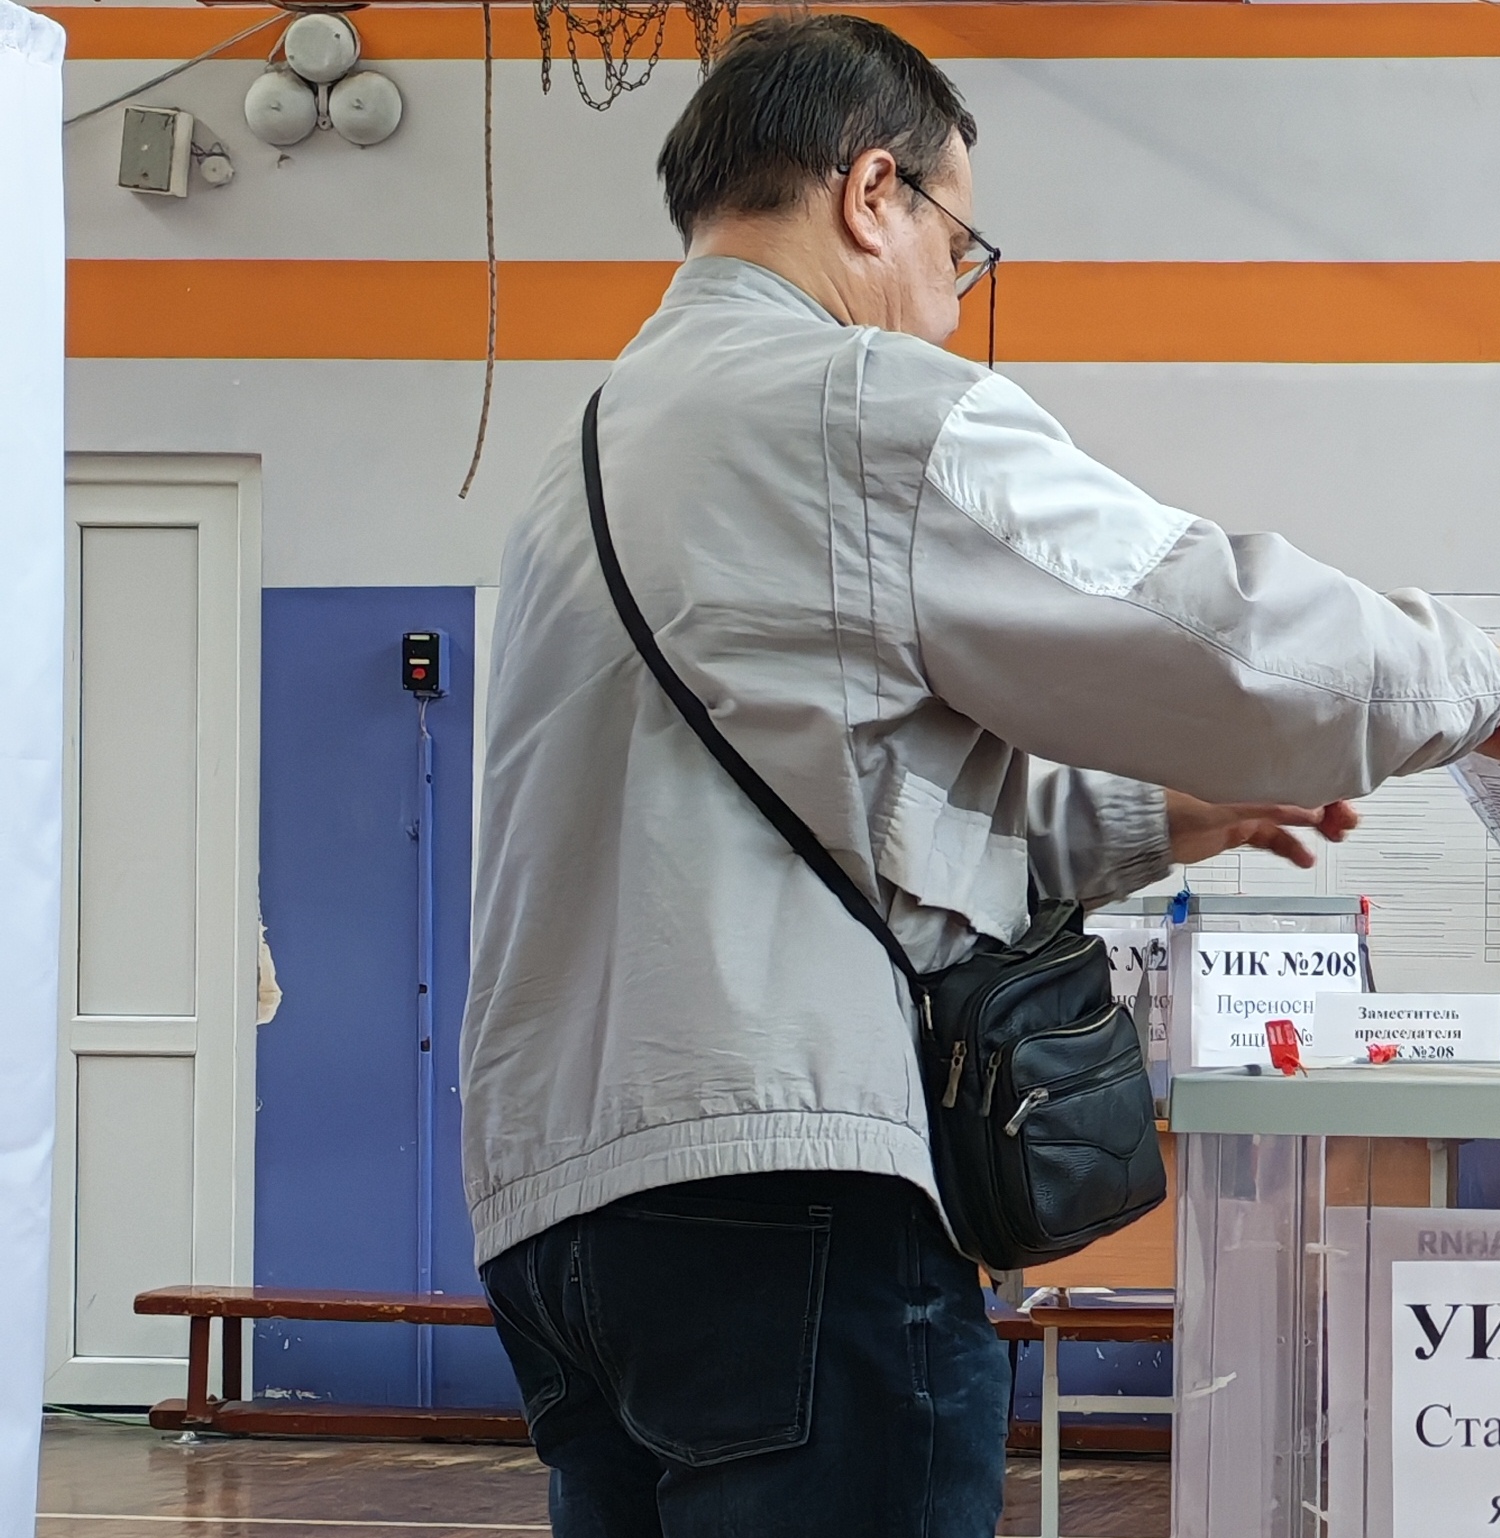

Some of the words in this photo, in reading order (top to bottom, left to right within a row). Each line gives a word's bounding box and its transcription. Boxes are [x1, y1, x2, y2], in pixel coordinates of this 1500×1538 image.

[1198, 950, 1269, 976] УИК
[1277, 951, 1357, 977] №208
[1358, 1006, 1460, 1020] Заместитель
[1230, 1033, 1265, 1047] ящ
[1354, 1028, 1462, 1042] председателя
[1408, 1045, 1455, 1059] №208
